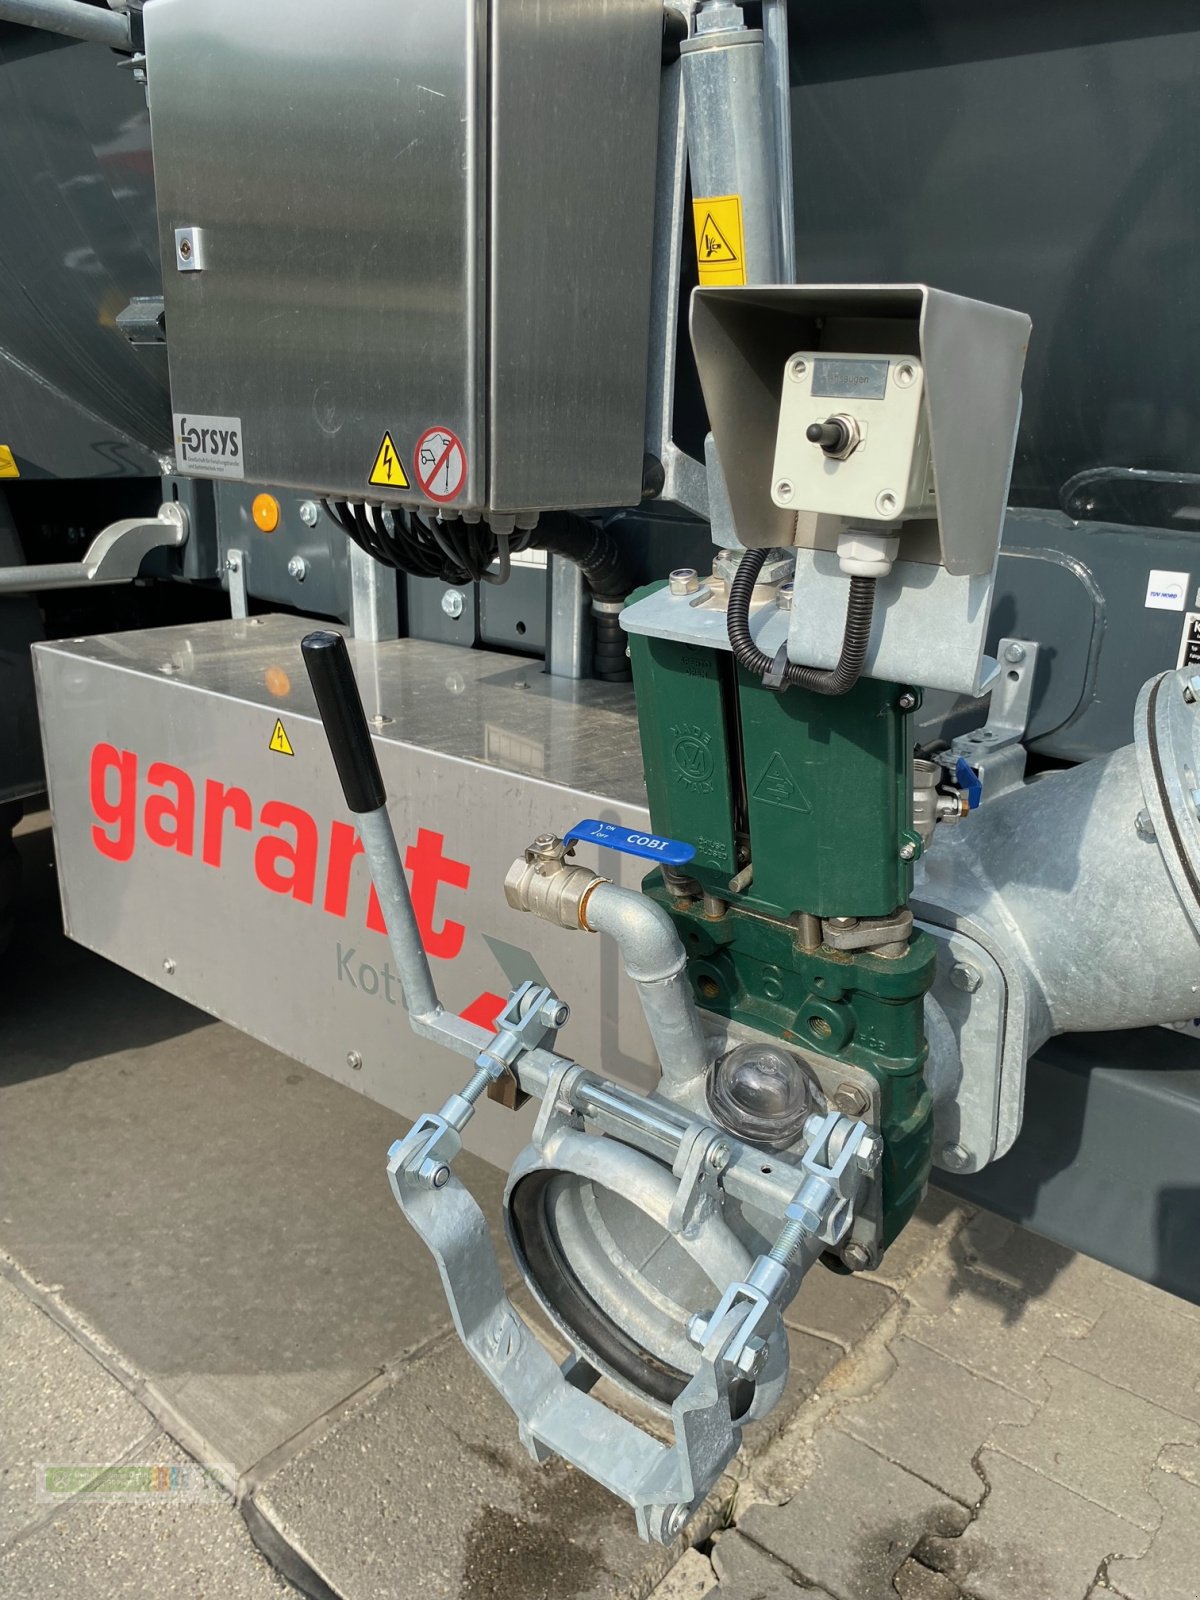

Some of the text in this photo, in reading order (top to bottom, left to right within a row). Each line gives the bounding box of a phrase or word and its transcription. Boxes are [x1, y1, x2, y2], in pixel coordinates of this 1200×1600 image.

[180, 417, 239, 461] forsys
[89, 741, 471, 959] garant
[627, 834, 669, 851] COBI
